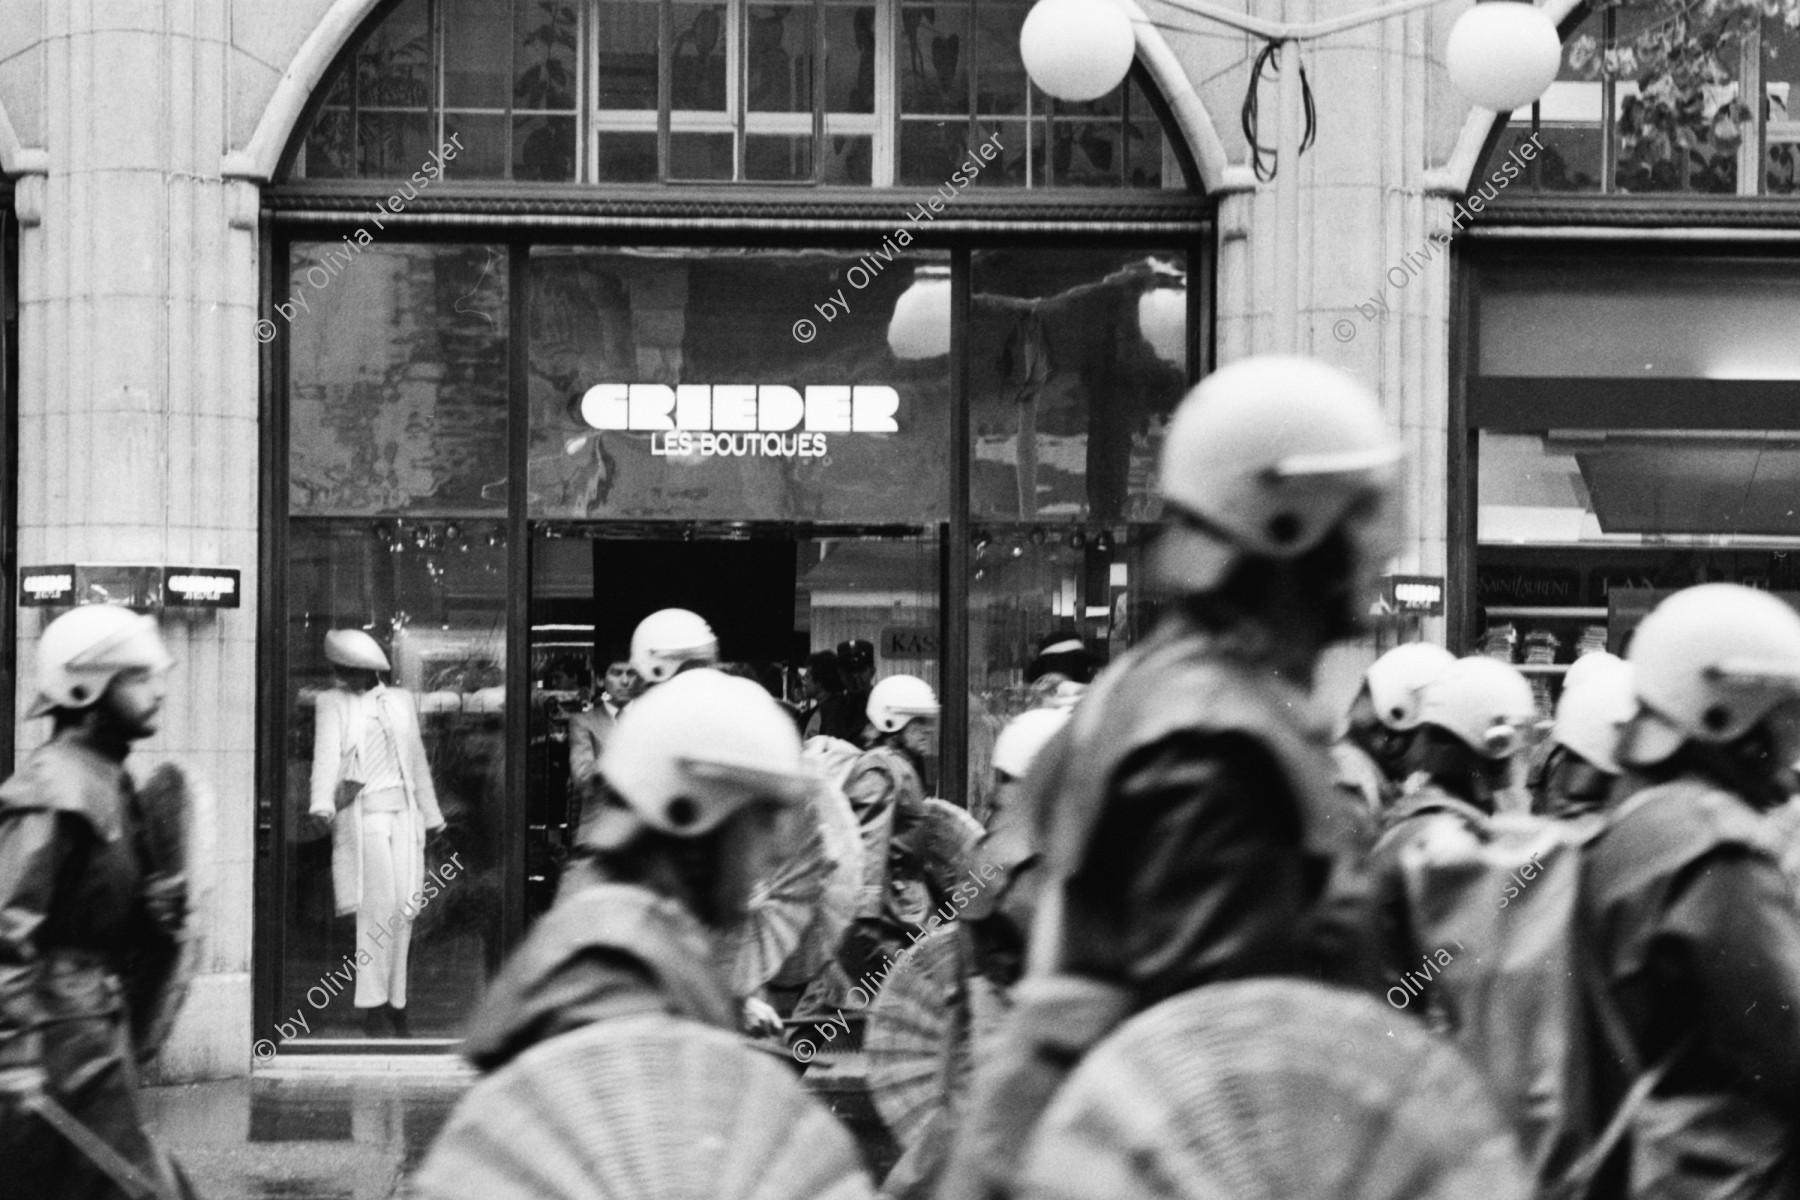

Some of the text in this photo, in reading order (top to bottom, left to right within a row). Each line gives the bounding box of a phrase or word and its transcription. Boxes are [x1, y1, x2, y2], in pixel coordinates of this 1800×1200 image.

[581, 383, 899, 432] GRIEDER
[651, 432, 827, 457] LES BOUTIQUES
[892, 633, 940, 653] KAS
